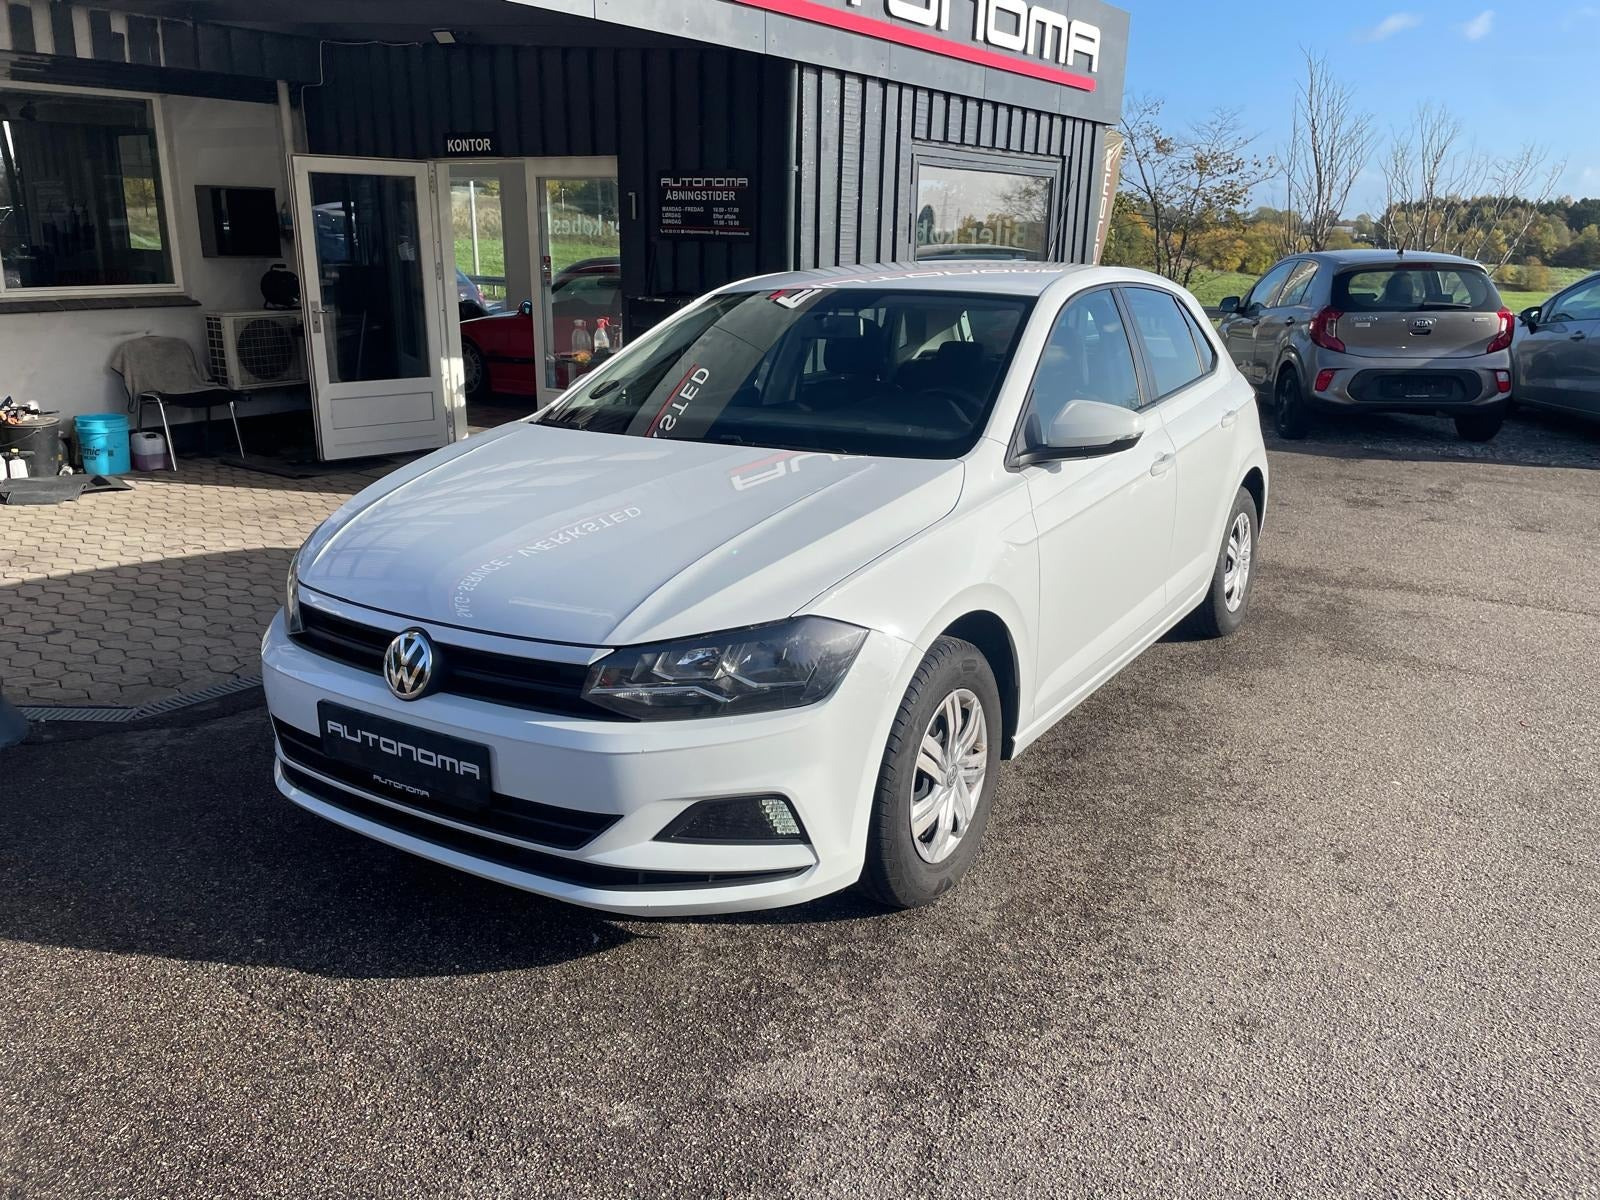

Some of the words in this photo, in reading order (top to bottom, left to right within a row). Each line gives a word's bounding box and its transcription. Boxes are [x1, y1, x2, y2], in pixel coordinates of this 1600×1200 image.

[447, 138, 491, 152] KONTOR
[660, 177, 748, 187] AUTONOMA
[666, 189, 736, 201] ÅBNINGSTIDER
[1414, 319, 1431, 328] KIA
[327, 719, 481, 780] AUTONOMA
[372, 774, 430, 798] AUTONOMA
